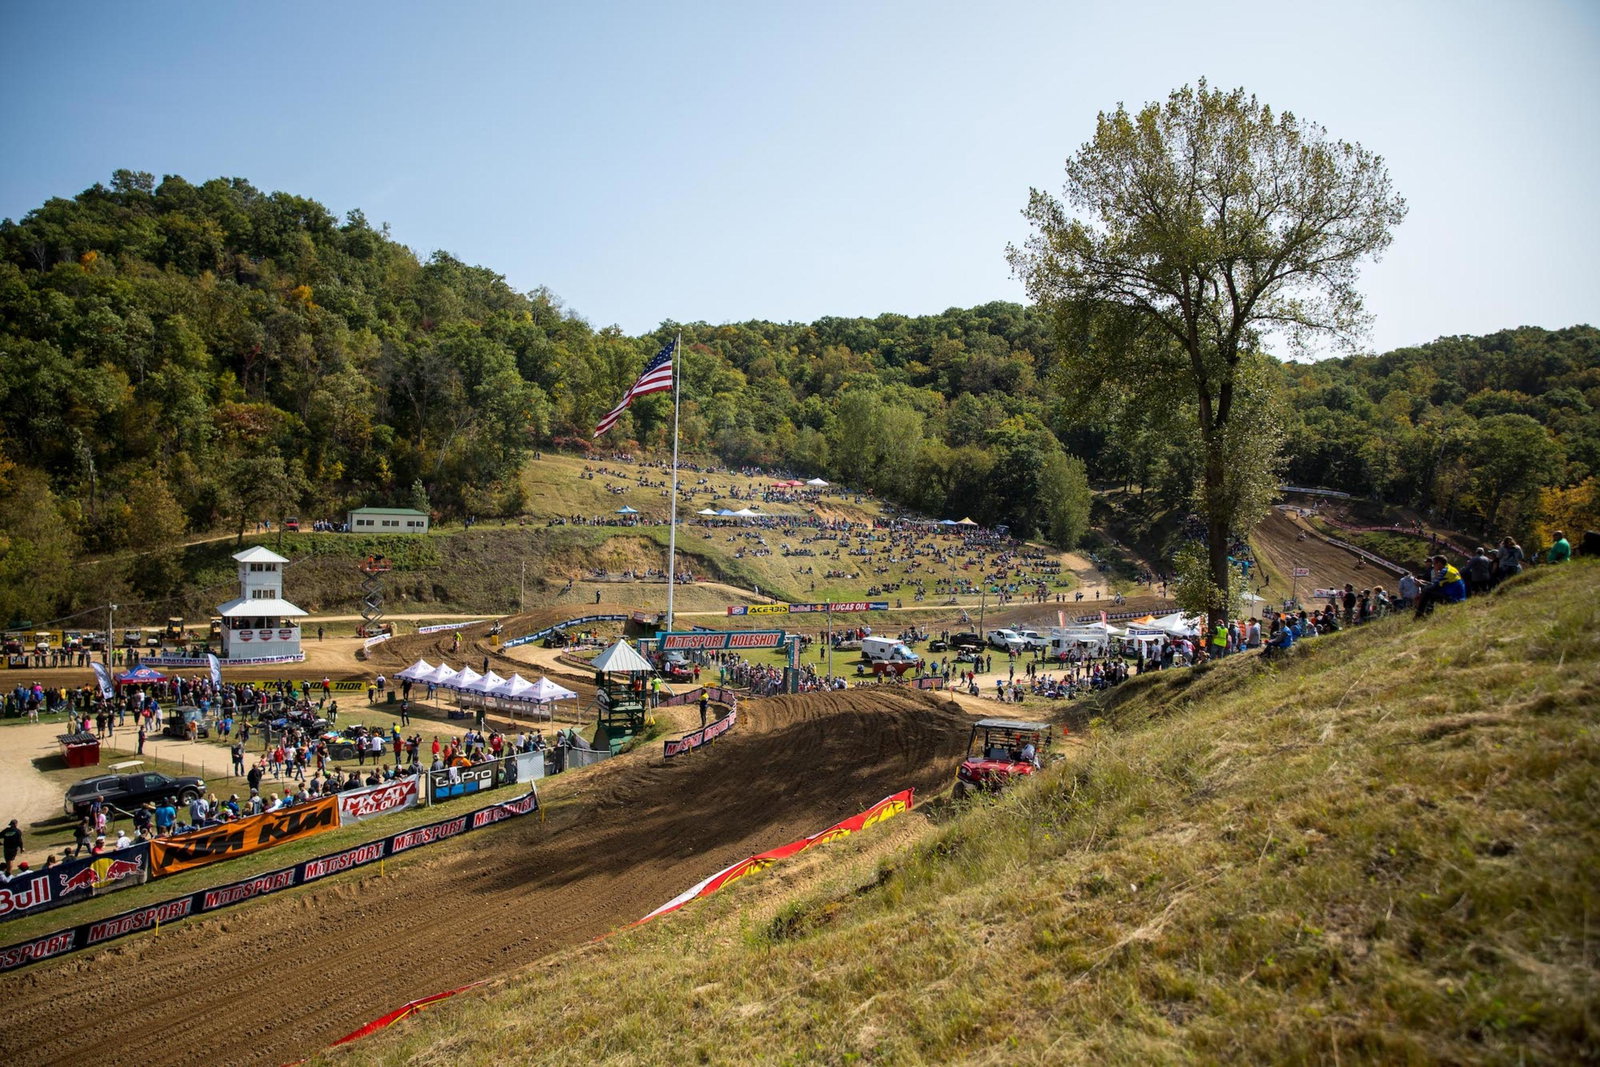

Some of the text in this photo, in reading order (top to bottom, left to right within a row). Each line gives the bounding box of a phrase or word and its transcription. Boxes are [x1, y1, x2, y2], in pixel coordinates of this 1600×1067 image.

[831, 603, 854, 611] LUCAS
[855, 602, 867, 610] OIL
[729, 634, 780, 647] HOLESHOT
[10, 656, 27, 665] CAT
[335, 682, 363, 690] THOR
[436, 769, 492, 787] GoPro
[345, 791, 377, 811] MX
[382, 782, 414, 800] ATV
[356, 797, 402, 816] ALL OUT
[160, 806, 333, 868] KTM KTM
[0, 875, 51, 915] Bull
